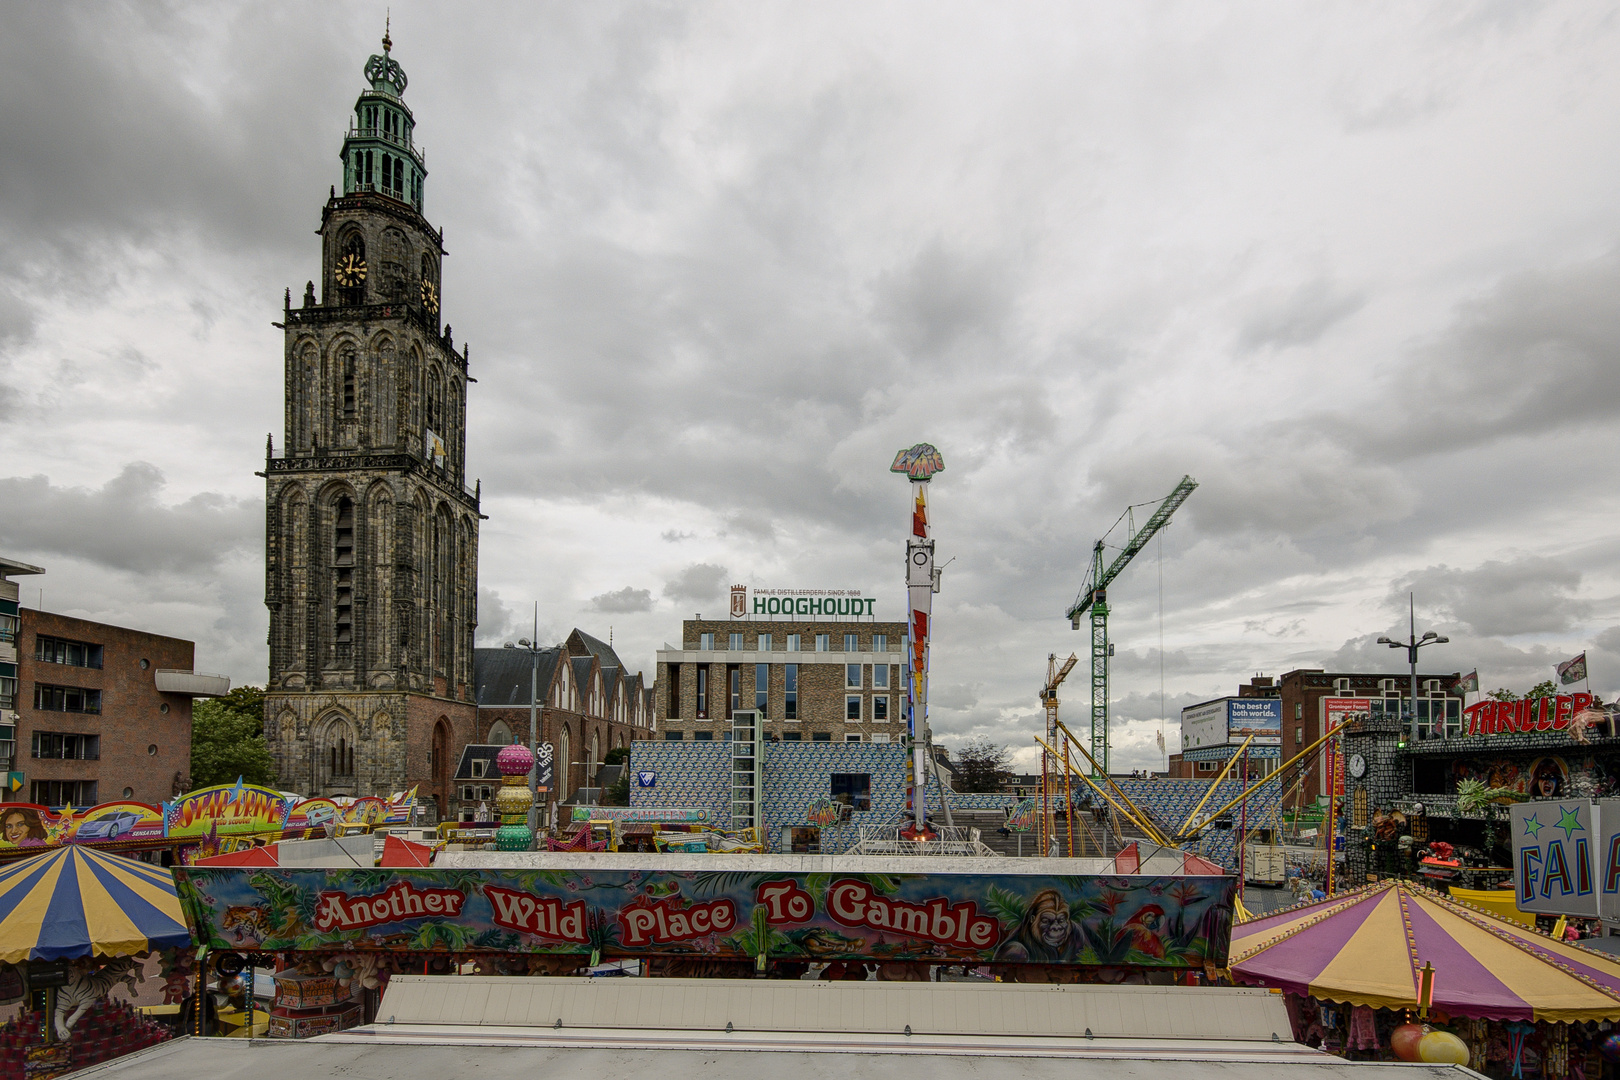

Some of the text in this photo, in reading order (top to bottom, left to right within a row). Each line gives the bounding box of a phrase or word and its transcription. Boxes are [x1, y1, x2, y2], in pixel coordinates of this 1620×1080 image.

[753, 597, 876, 615] HOOGHOUDT
[1463, 692, 1594, 736] THRILLER
[537, 742, 553, 758] 85
[180, 788, 281, 828] STAR DRIVE
[590, 809, 687, 820] BOGSCHIETEN
[132, 829, 162, 837] SENSATION
[318, 884, 992, 944] Another Wild Place To Gamble
